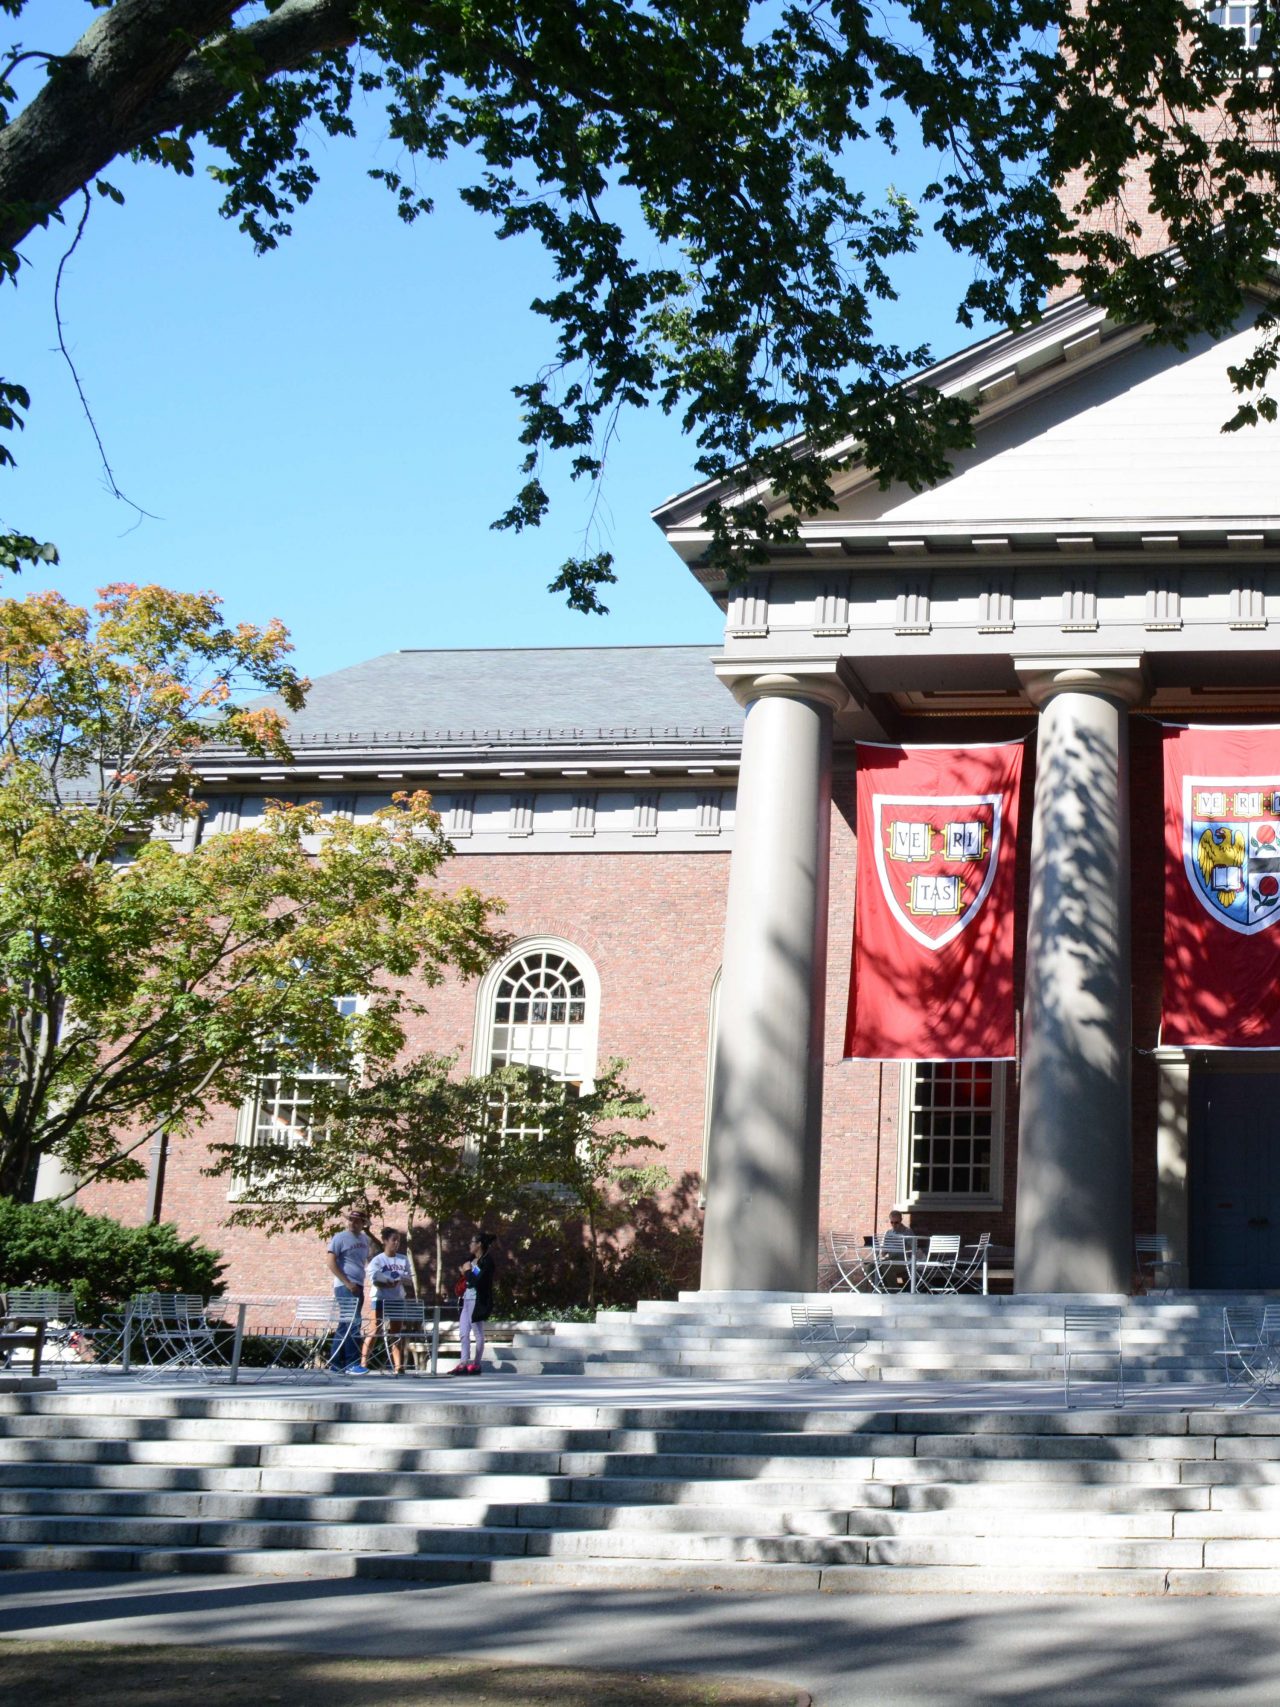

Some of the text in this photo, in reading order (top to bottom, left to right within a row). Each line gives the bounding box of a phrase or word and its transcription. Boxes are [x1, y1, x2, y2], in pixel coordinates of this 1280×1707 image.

[1201, 797, 1220, 808] VE
[1240, 796, 1256, 808] RI
[898, 831, 973, 848] VE RI
[920, 885, 952, 900] TAS
